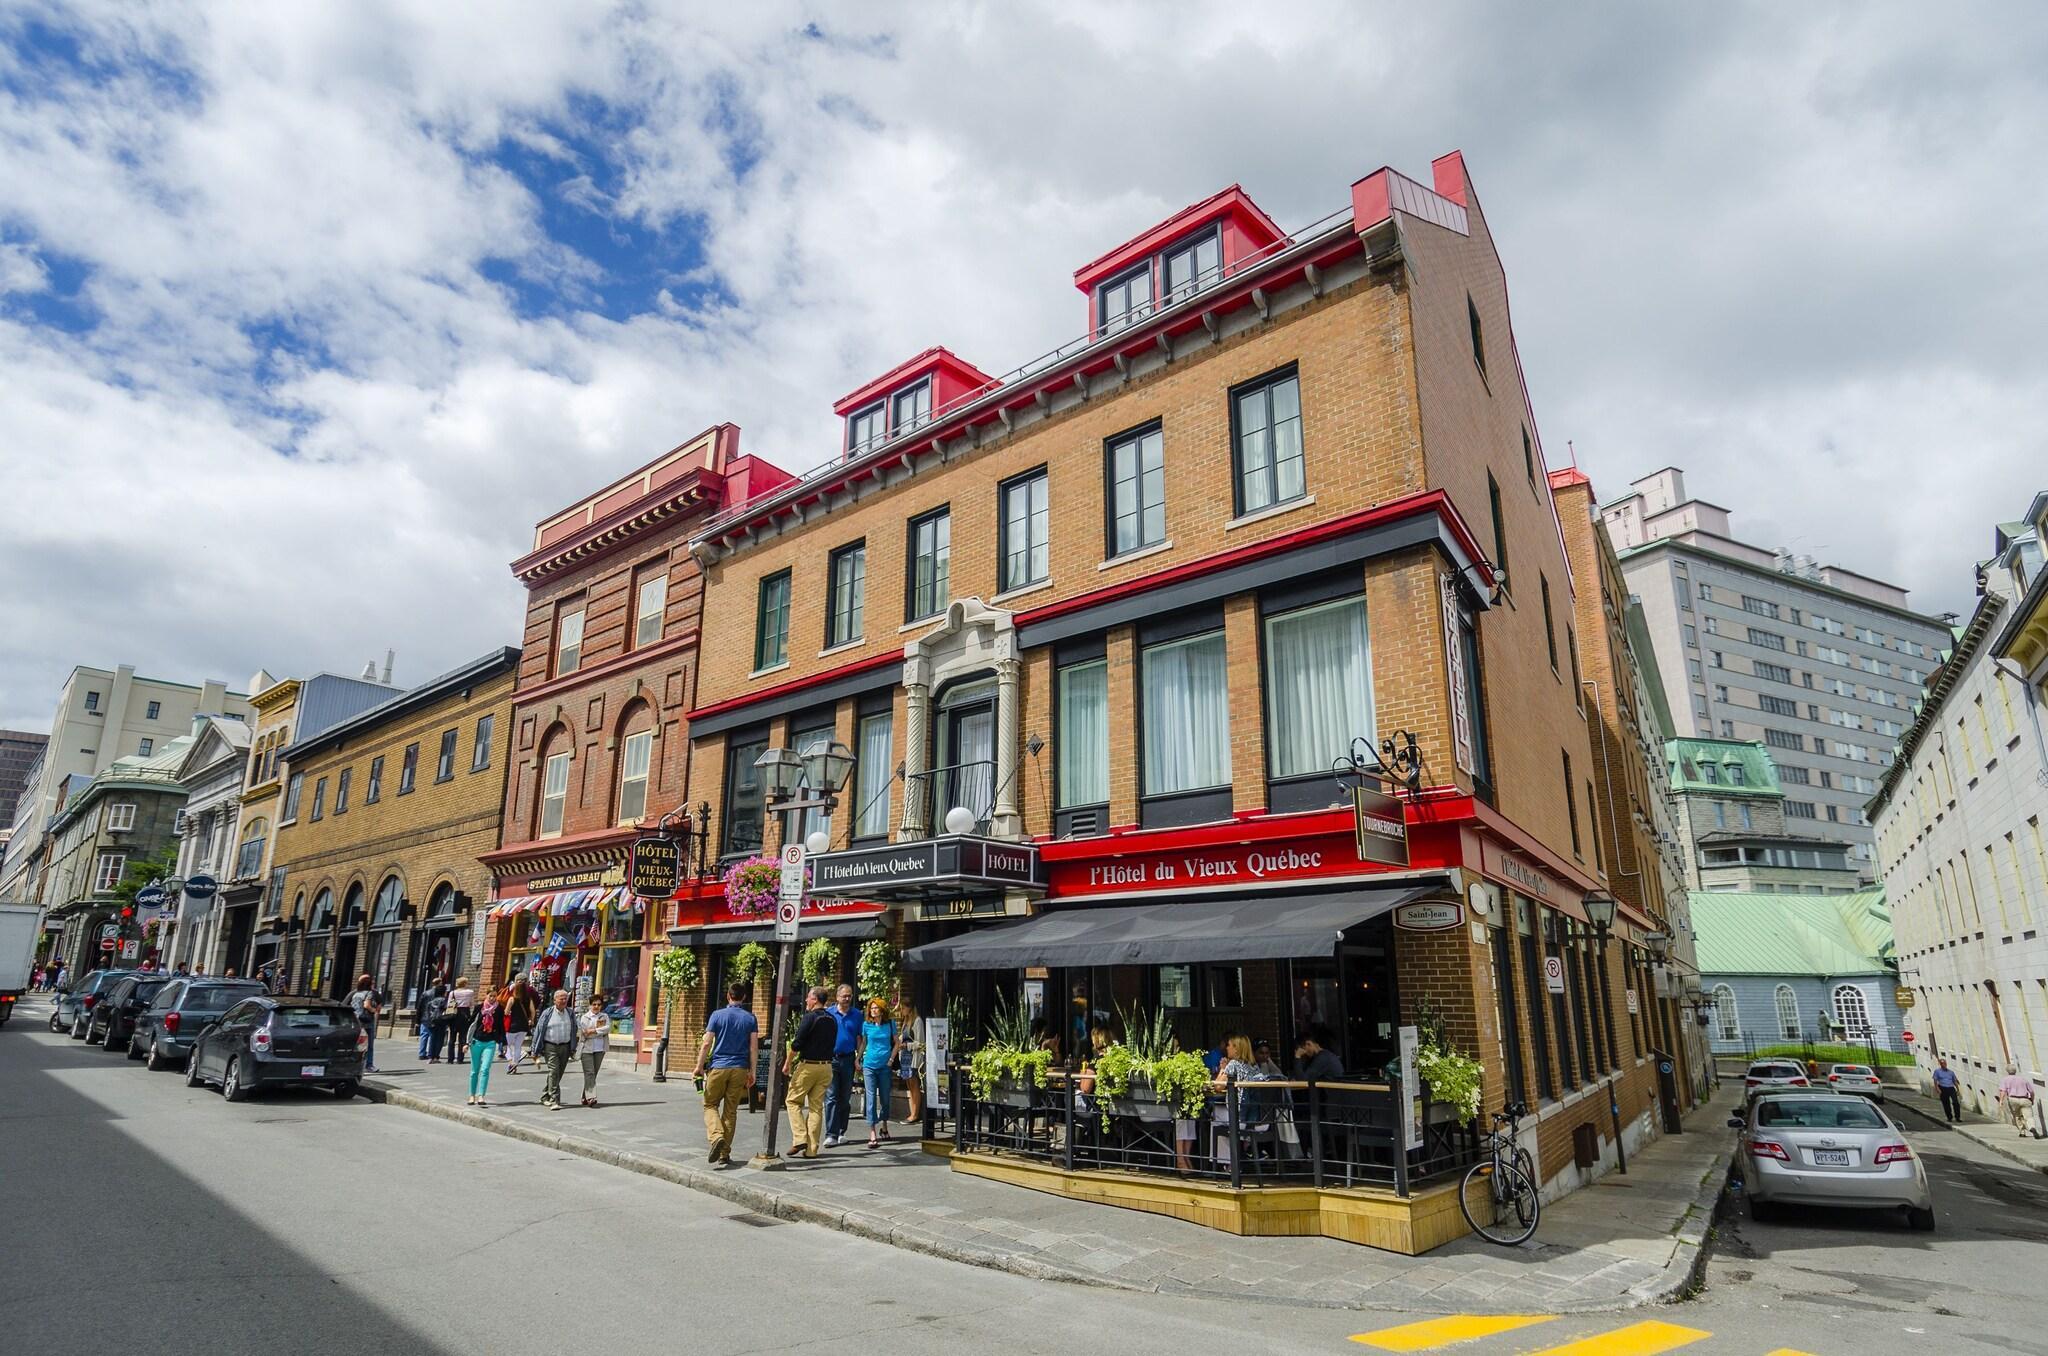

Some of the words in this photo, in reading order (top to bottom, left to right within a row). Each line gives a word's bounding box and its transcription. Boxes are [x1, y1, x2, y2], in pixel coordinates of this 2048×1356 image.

[637, 843, 676, 859] HÔTEL
[639, 865, 673, 876] VIEUX-
[988, 853, 1028, 873] HÔTEL
[1090, 863, 1146, 886] l'Hôtel
[1154, 861, 1175, 882] du
[1183, 857, 1238, 879] Vieux
[1246, 848, 1322, 878] Québec
[823, 863, 853, 880] l'Hôtel
[853, 863, 865, 877] du
[529, 876, 565, 890] STATION
[634, 874, 676, 888] QUÉBEC
[949, 899, 973, 914] 1190
[1407, 910, 1448, 920] Saint-Jean
